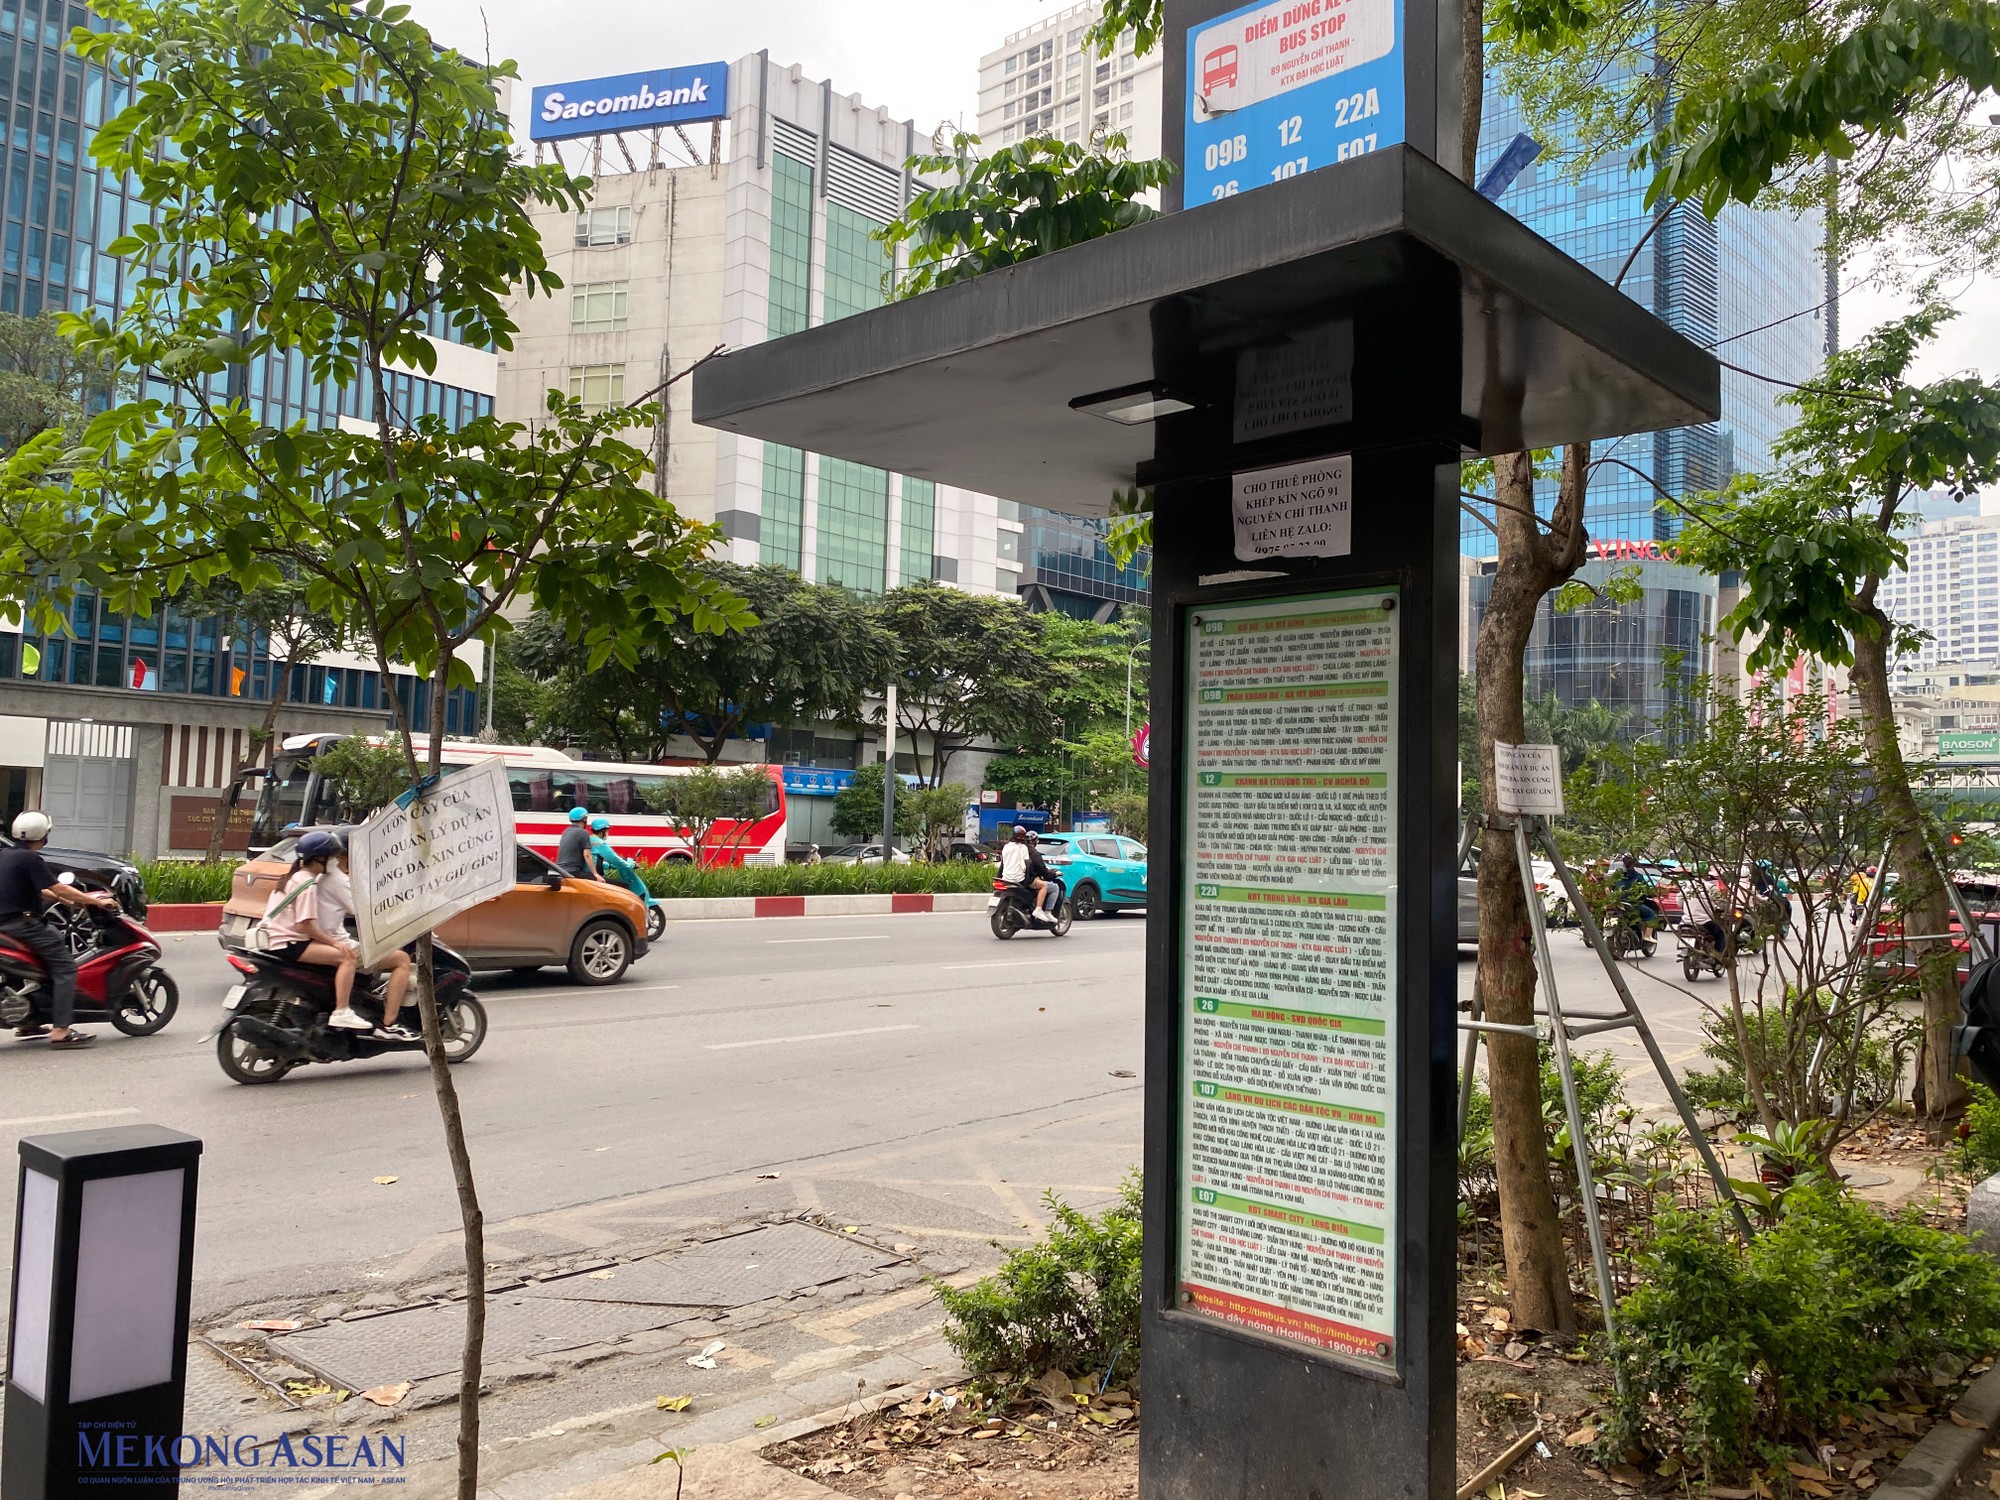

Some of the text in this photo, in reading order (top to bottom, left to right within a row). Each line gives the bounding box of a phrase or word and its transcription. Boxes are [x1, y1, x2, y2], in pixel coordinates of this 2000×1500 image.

[1245, 15, 1278, 43] ĐIỂM
[1283, 0, 1320, 29] DỪNG
[1280, 13, 1346, 54] BUS STOP
[1270, 38, 1350, 76] 89 NGUYỄN CHÍ THANH
[1280, 55, 1345, 87] KTX ĐẠI HỌC LUẬT
[541, 78, 710, 122] Sacombank
[1205, 87, 1380, 171] 09B 12 22A
[1244, 469, 1342, 495] CHO THUÊ PHÒNG
[1246, 486, 1338, 510] KHÉP KÍN NGÕ 91
[1284, 505, 1304, 519] CHÍ
[1307, 501, 1348, 517] THANH
[1252, 522, 1332, 542] LIÊN HỆ ZALO:
[1594, 539, 1684, 561] VINCO
[1205, 621, 1223, 633] 09B
[1203, 690, 1221, 700] 09B
[1204, 774, 1214, 783] 12
[382, 788, 472, 837] VƯỜN CÂY CỦA
[374, 806, 492, 870] BAN QUẢN LÝ DỰ ÁN
[375, 829, 494, 892] ĐỐNG ĐA, XIN CÙNG
[374, 850, 498, 916] CHUNG TAY GIỮ GÌN!
[1200, 886, 1217, 896] 22A
[1201, 999, 1213, 1010] 26
[1199, 1083, 1214, 1095] 107
[1199, 1189, 1213, 1202] E07
[1263, 1207, 1286, 1221] SMART
[1288, 1213, 1304, 1225] CITY
[1311, 1218, 1329, 1230] LONG
[1276, 1324, 1323, 1347] (Hotline):
[1304, 1320, 1378, 1349] http://timbuyt.v
